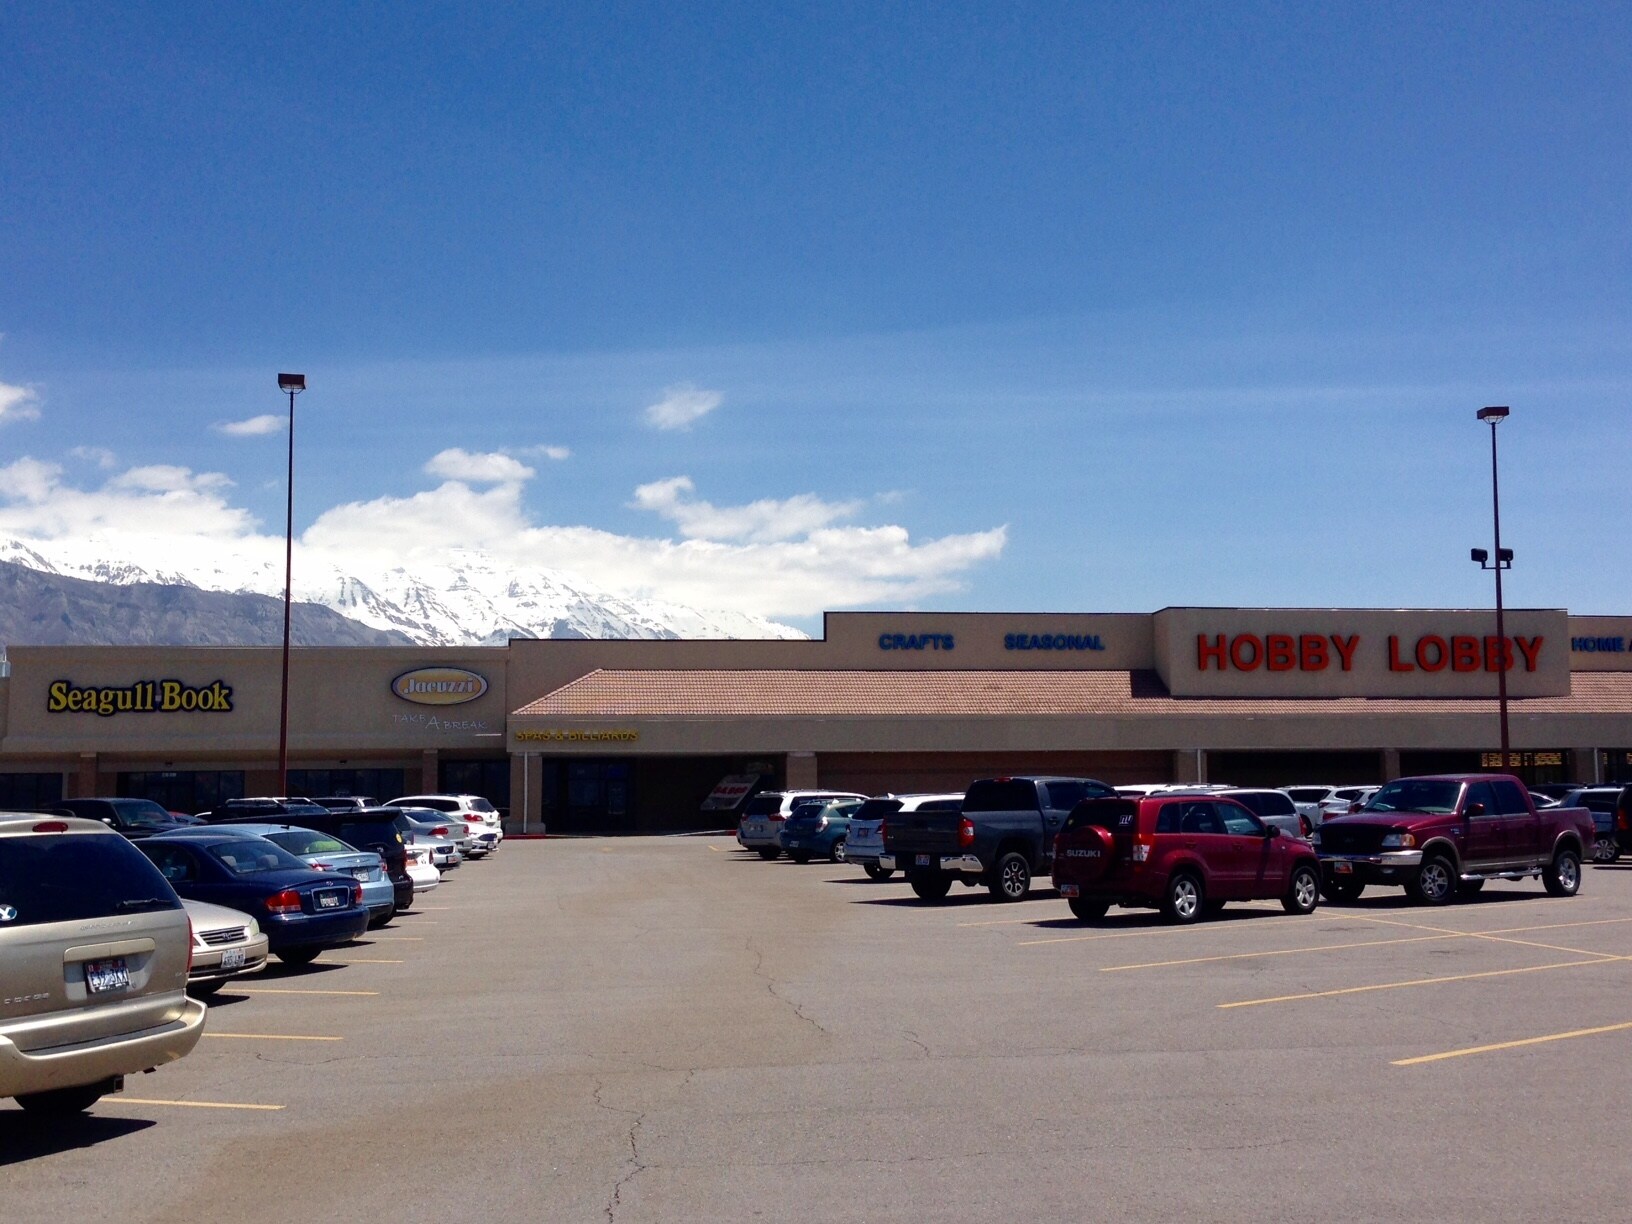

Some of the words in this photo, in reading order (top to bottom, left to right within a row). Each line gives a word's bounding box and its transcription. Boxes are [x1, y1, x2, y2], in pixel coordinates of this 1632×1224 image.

[879, 634, 954, 650] CRAFTS
[1004, 634, 1105, 650] SEASONAL
[1571, 636, 1625, 652] HOME
[1197, 633, 1360, 672] HOBBY
[1388, 634, 1544, 673] LOBBY
[403, 678, 474, 694] Jacuzzi
[48, 681, 154, 716] Seagull
[161, 681, 231, 712] Book
[393, 714, 425, 722] TAKE
[425, 716, 440, 730] A
[443, 720, 486, 730] BREAK
[515, 730, 550, 741] SPAS
[568, 730, 639, 741] BILLIARDS
[1066, 849, 1101, 858] SUZUKI
